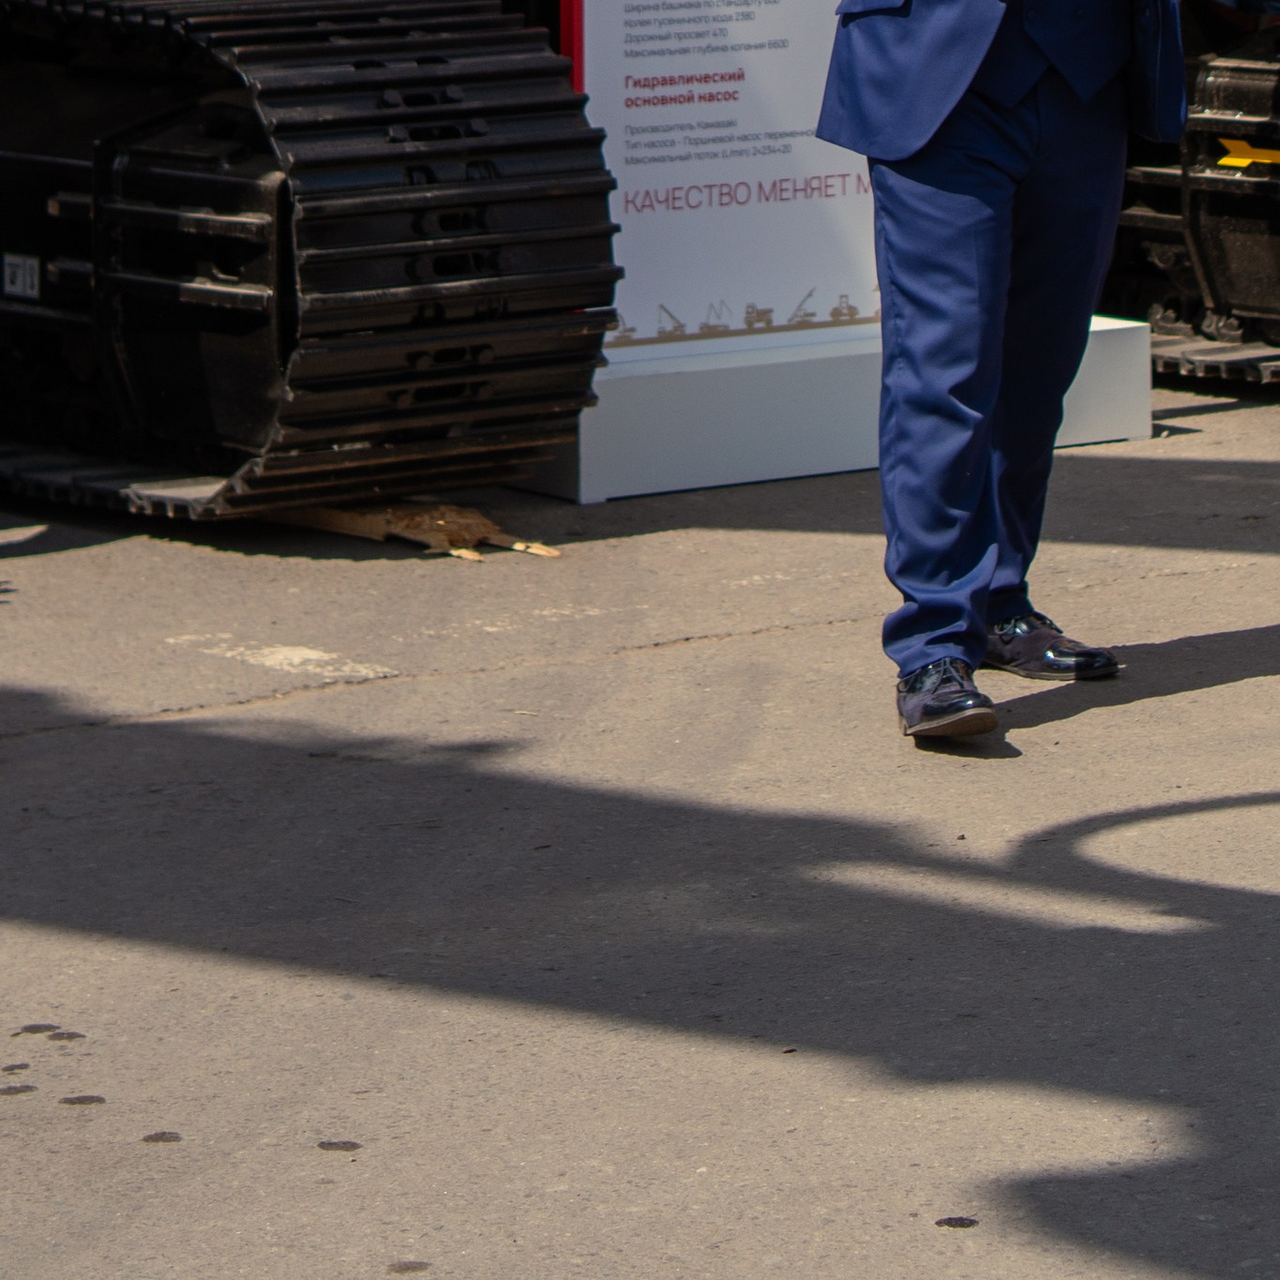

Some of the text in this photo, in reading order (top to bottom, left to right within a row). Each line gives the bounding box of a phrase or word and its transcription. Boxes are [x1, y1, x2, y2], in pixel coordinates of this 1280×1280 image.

[624, 67, 745, 91] Гидравлический
[625, 90, 739, 109] основной насос
[763, 128, 817, 142] переменно
[623, 181, 752, 214] КАЧЕСТВО
[757, 173, 851, 204] МЕНЯЕТ
